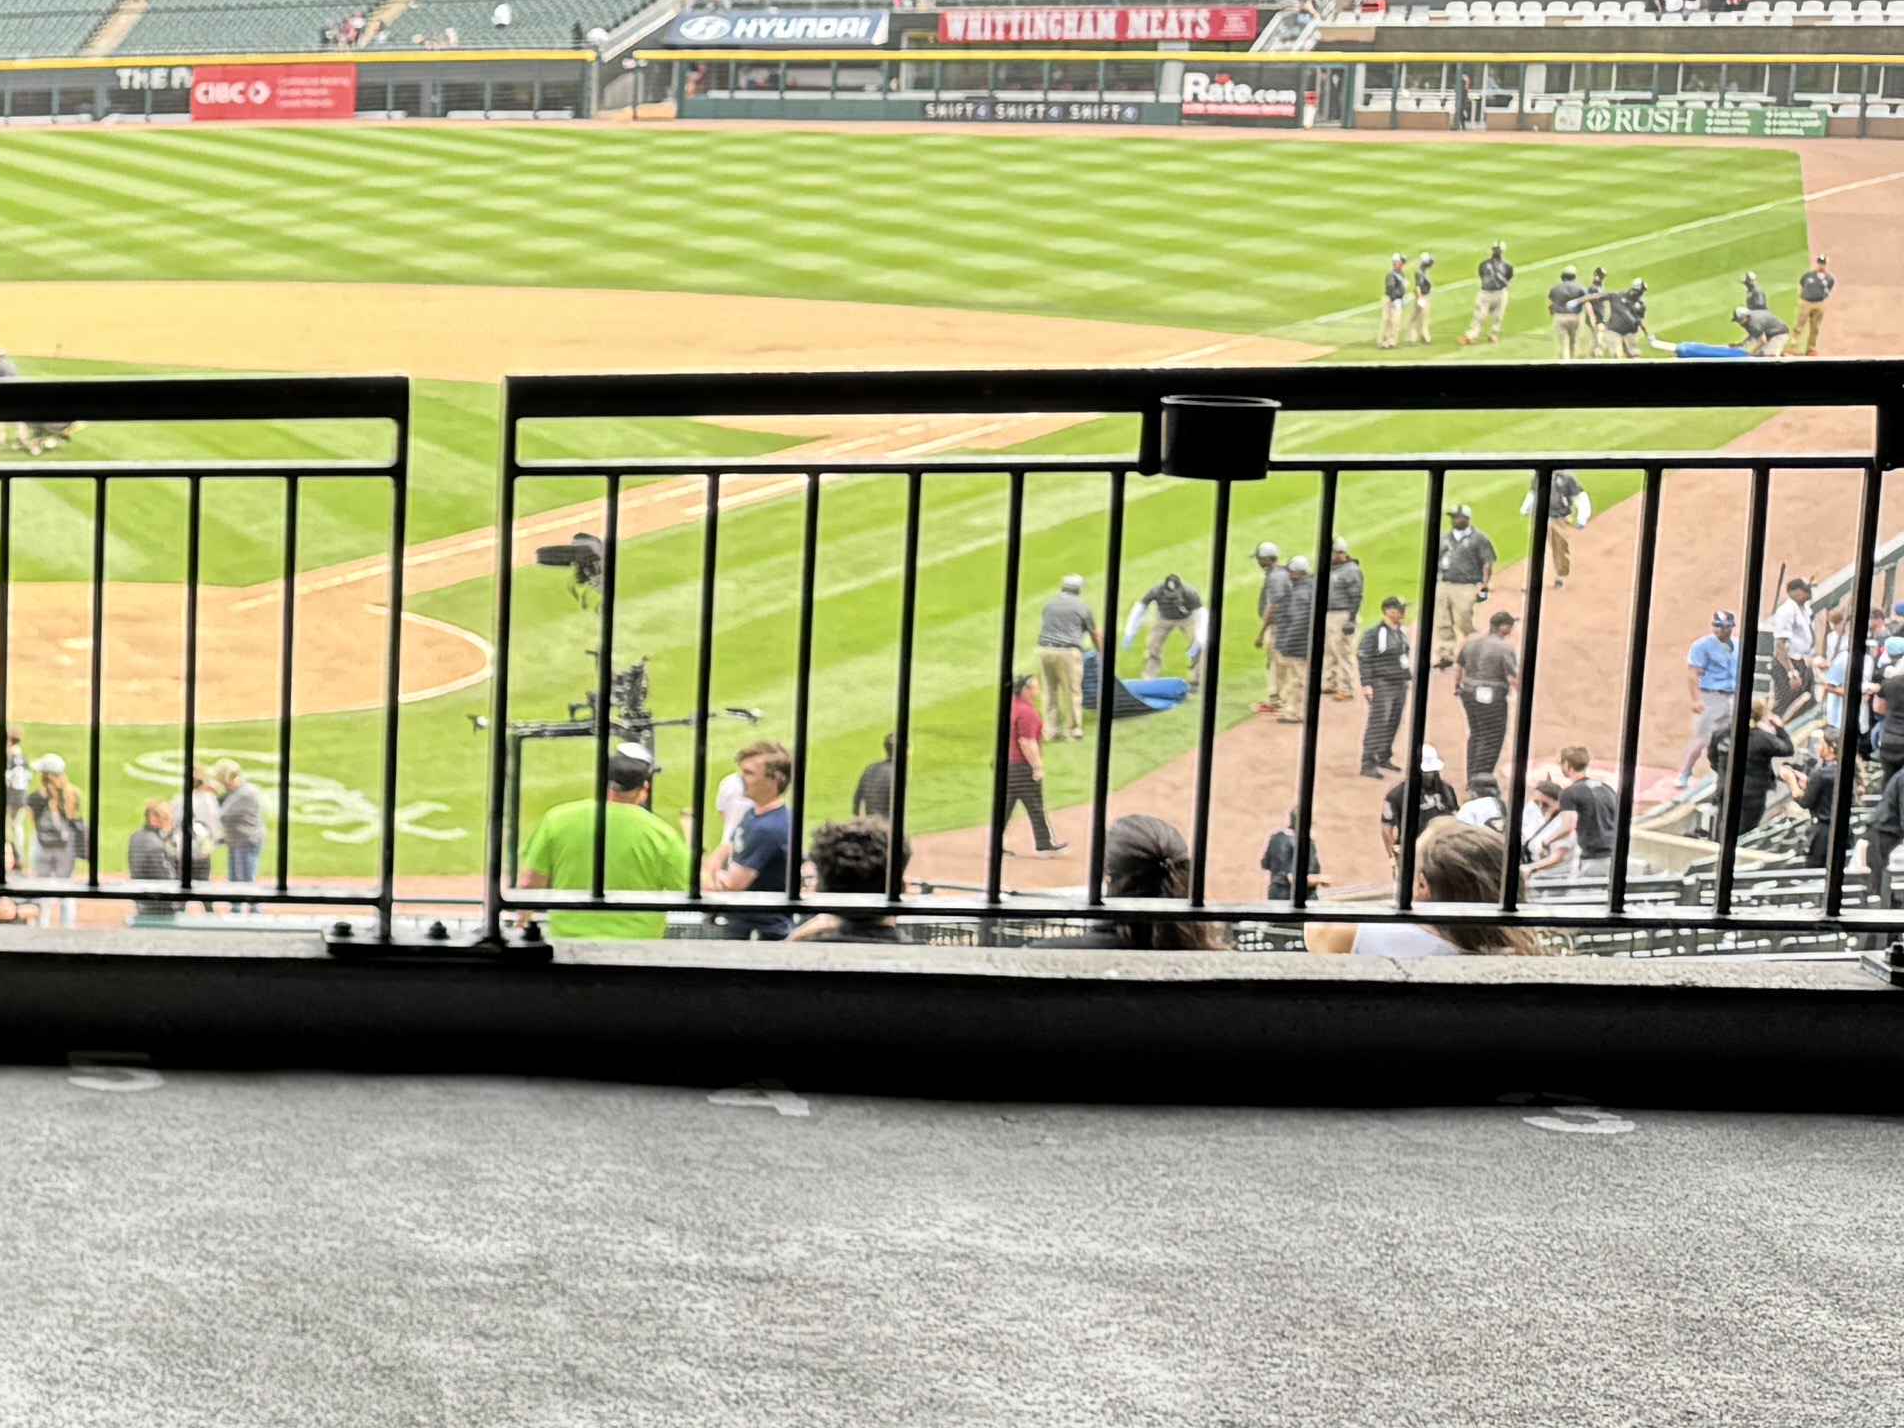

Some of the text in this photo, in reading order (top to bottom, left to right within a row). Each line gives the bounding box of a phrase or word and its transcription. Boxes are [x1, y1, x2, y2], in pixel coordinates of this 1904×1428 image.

[732, 17, 872, 39] HYUNDAI
[945, 10, 1117, 41] WHITTINGHAM
[1127, 8, 1211, 39] MEATS
[116, 67, 168, 90] THE
[1183, 72, 1297, 104] Rate.com
[194, 81, 248, 105] CIBC
[1614, 107, 1694, 133] RUSH
